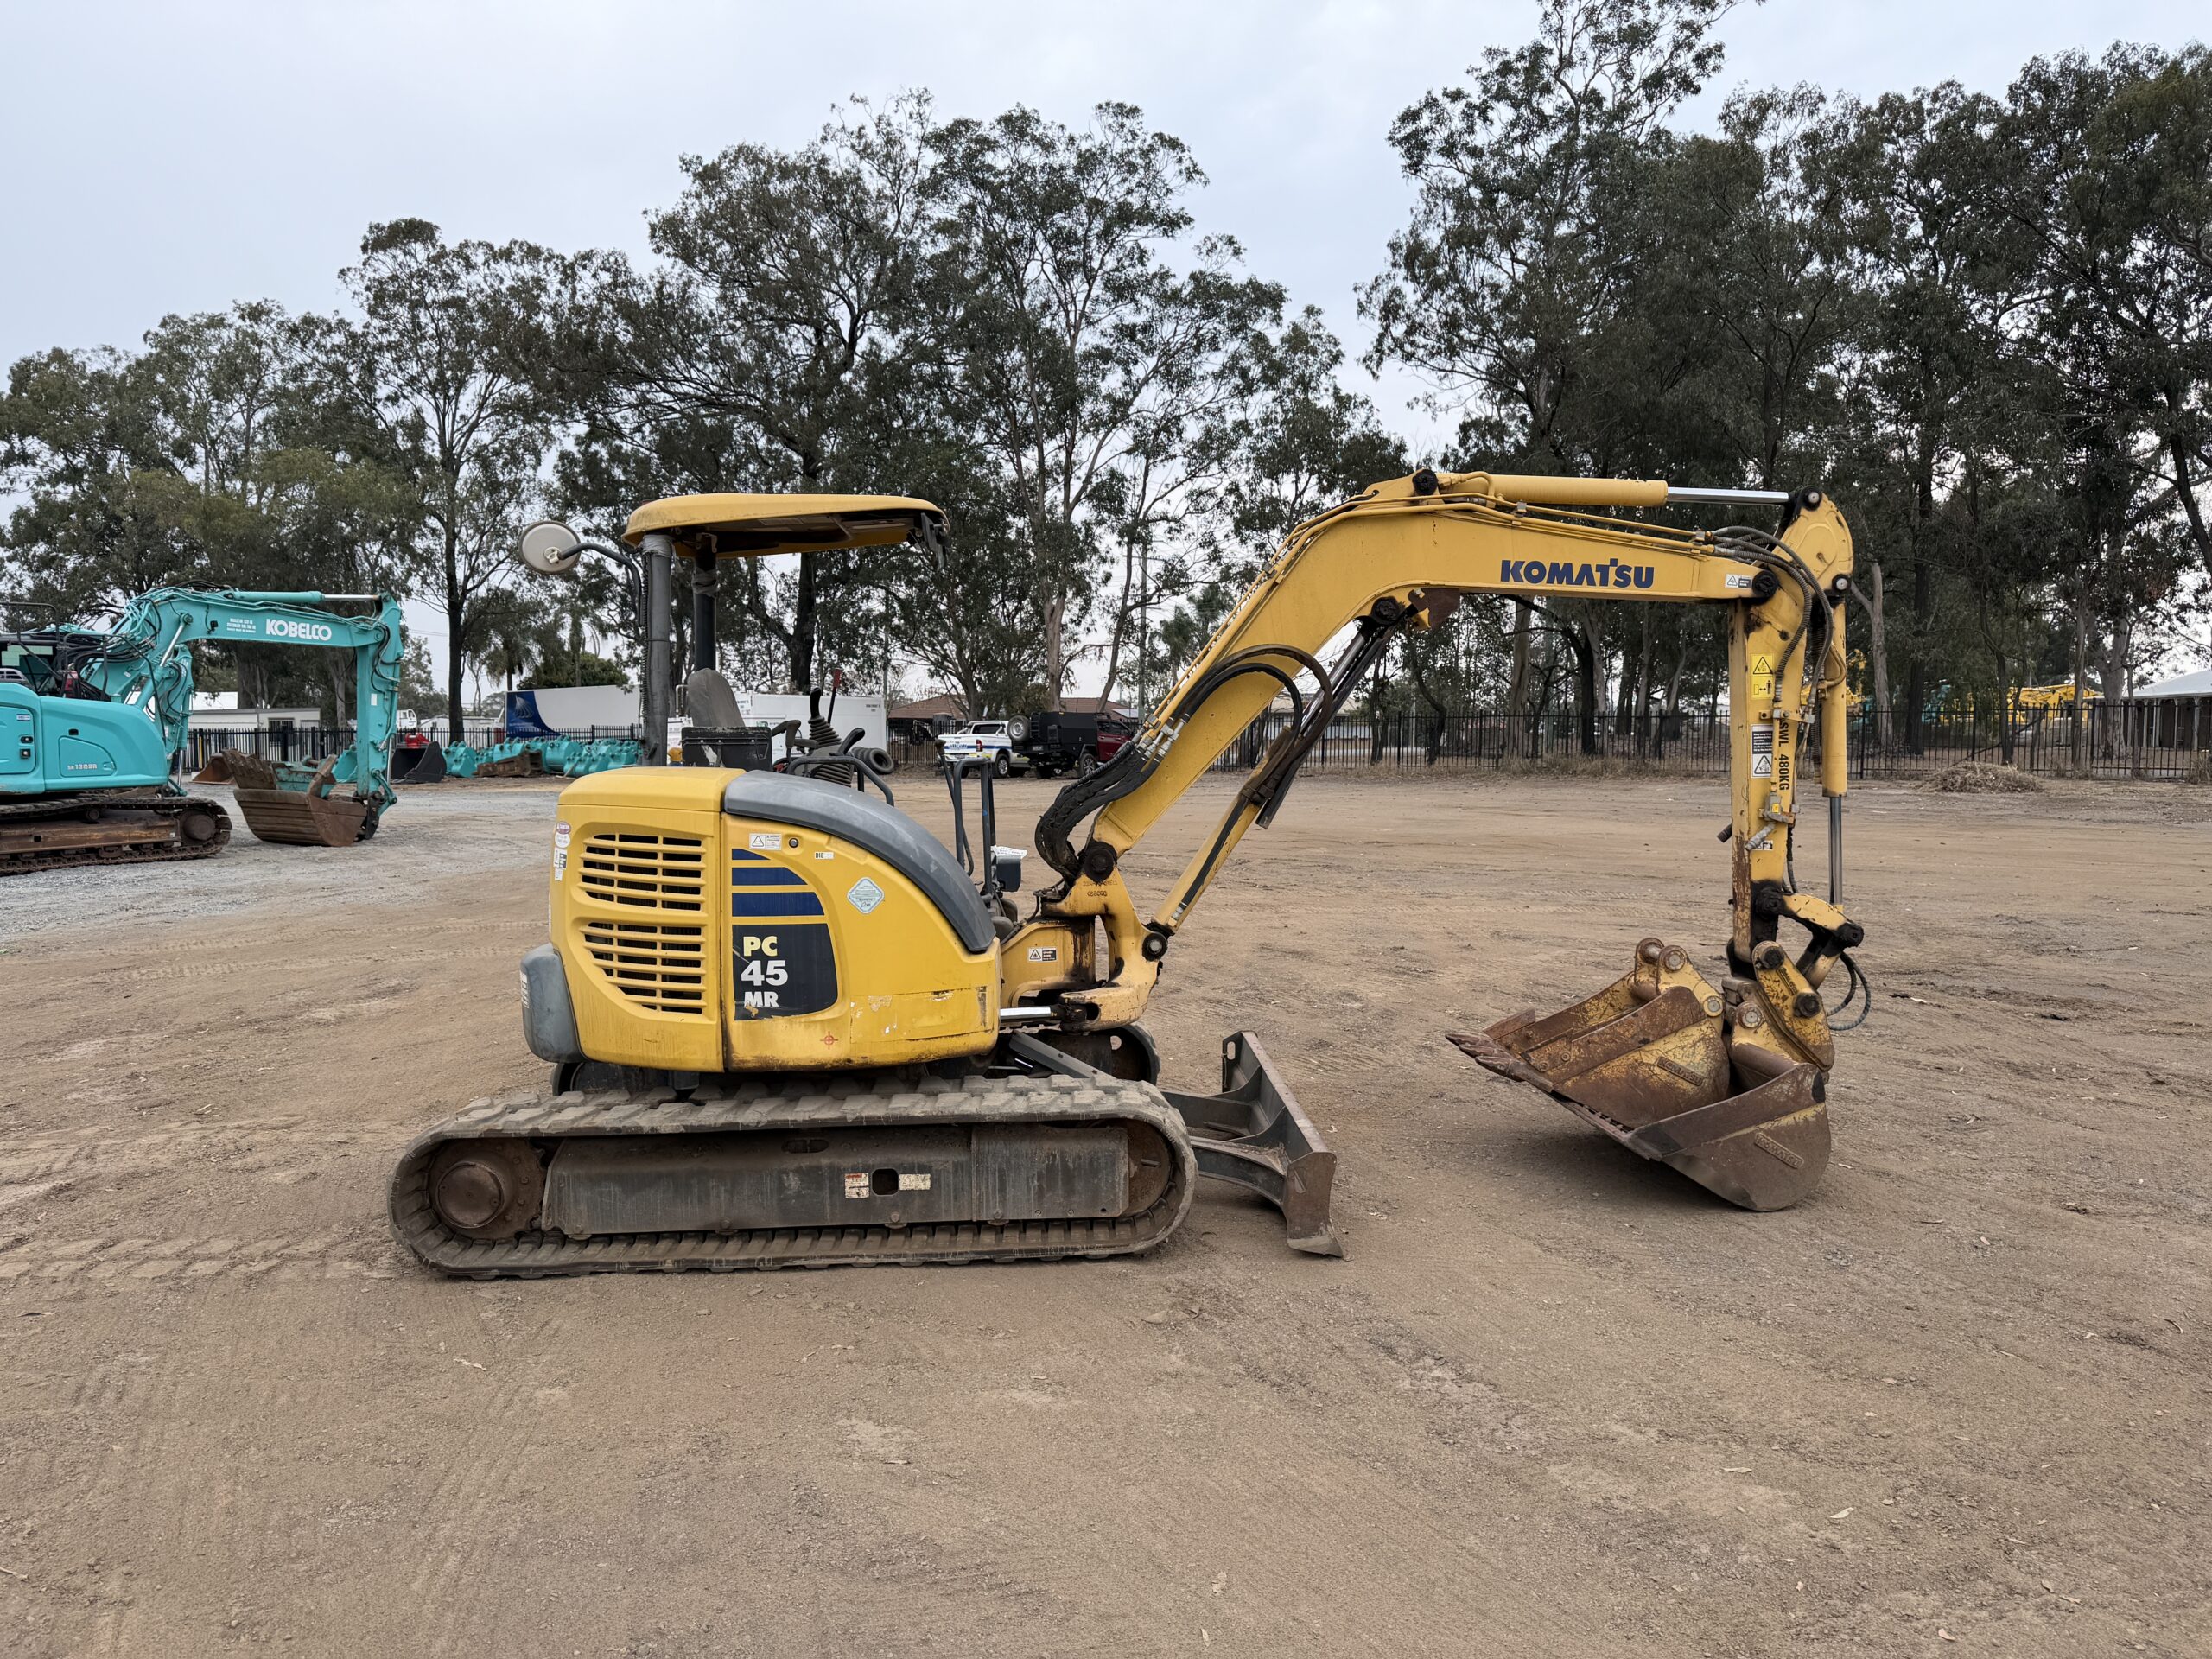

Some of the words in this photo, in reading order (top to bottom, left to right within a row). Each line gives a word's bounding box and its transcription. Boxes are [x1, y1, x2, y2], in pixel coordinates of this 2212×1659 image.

[1501, 558, 1654, 588] KOMATSU
[266, 619, 332, 641] KOBELCO
[1778, 722, 1789, 747] SWL
[1778, 754, 1789, 791] 480KG
[743, 936, 778, 957] PC
[741, 960, 788, 986] 45
[744, 991, 779, 1008] MR
[1756, 1134, 1802, 1166] KOMATSU
